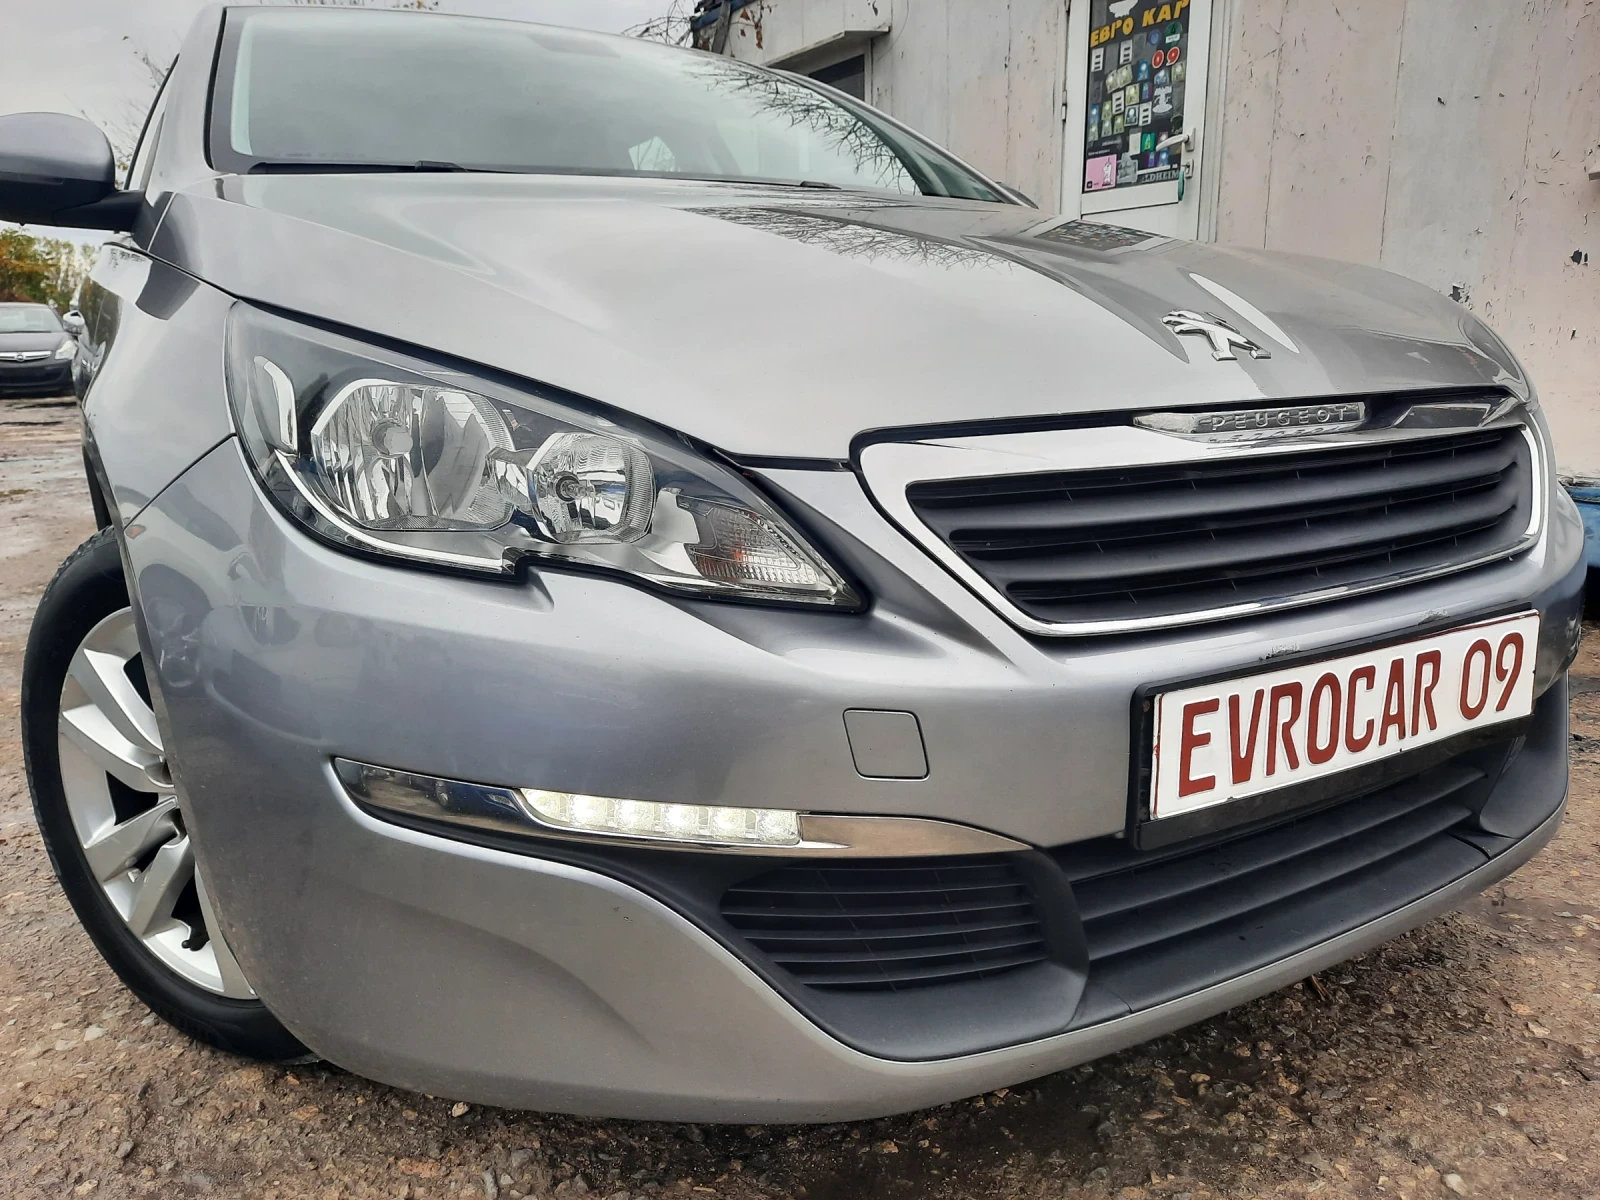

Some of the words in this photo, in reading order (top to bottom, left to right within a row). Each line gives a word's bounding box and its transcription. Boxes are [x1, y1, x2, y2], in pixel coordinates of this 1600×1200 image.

[1090, 17, 1134, 47] ЕВРО
[1141, 0, 1190, 28] КАР
[1211, 405, 1348, 431] PEUGEOT
[1178, 649, 1442, 798] EVROCAR
[1459, 632, 1524, 720] 09
